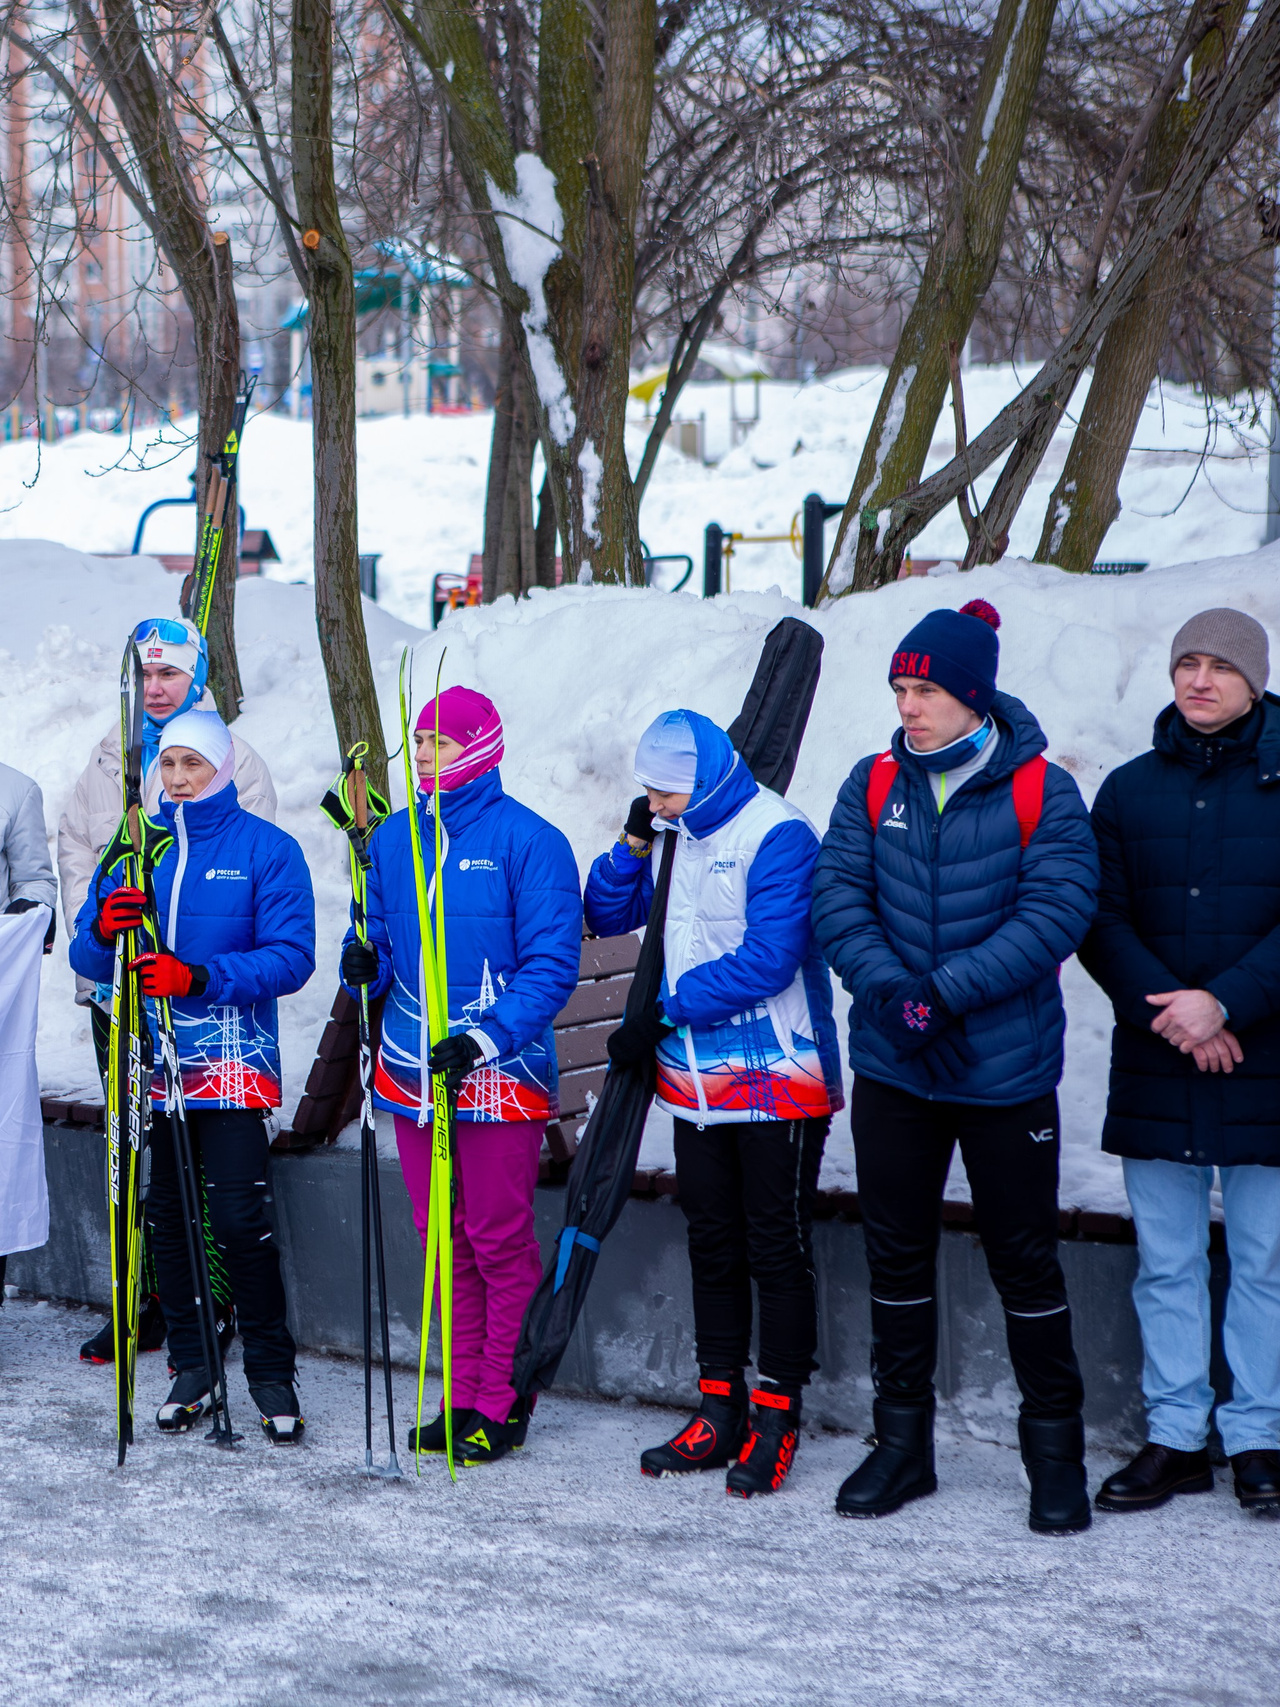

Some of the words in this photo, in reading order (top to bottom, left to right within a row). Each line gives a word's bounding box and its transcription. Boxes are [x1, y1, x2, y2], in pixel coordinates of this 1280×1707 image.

[892, 652, 931, 678] CSKA
[128, 1031, 142, 1152] FISCHER
[435, 1072, 448, 1161] FISCHER
[1028, 1128, 1054, 1142] VC
[110, 1110, 120, 1206] FISCHER
